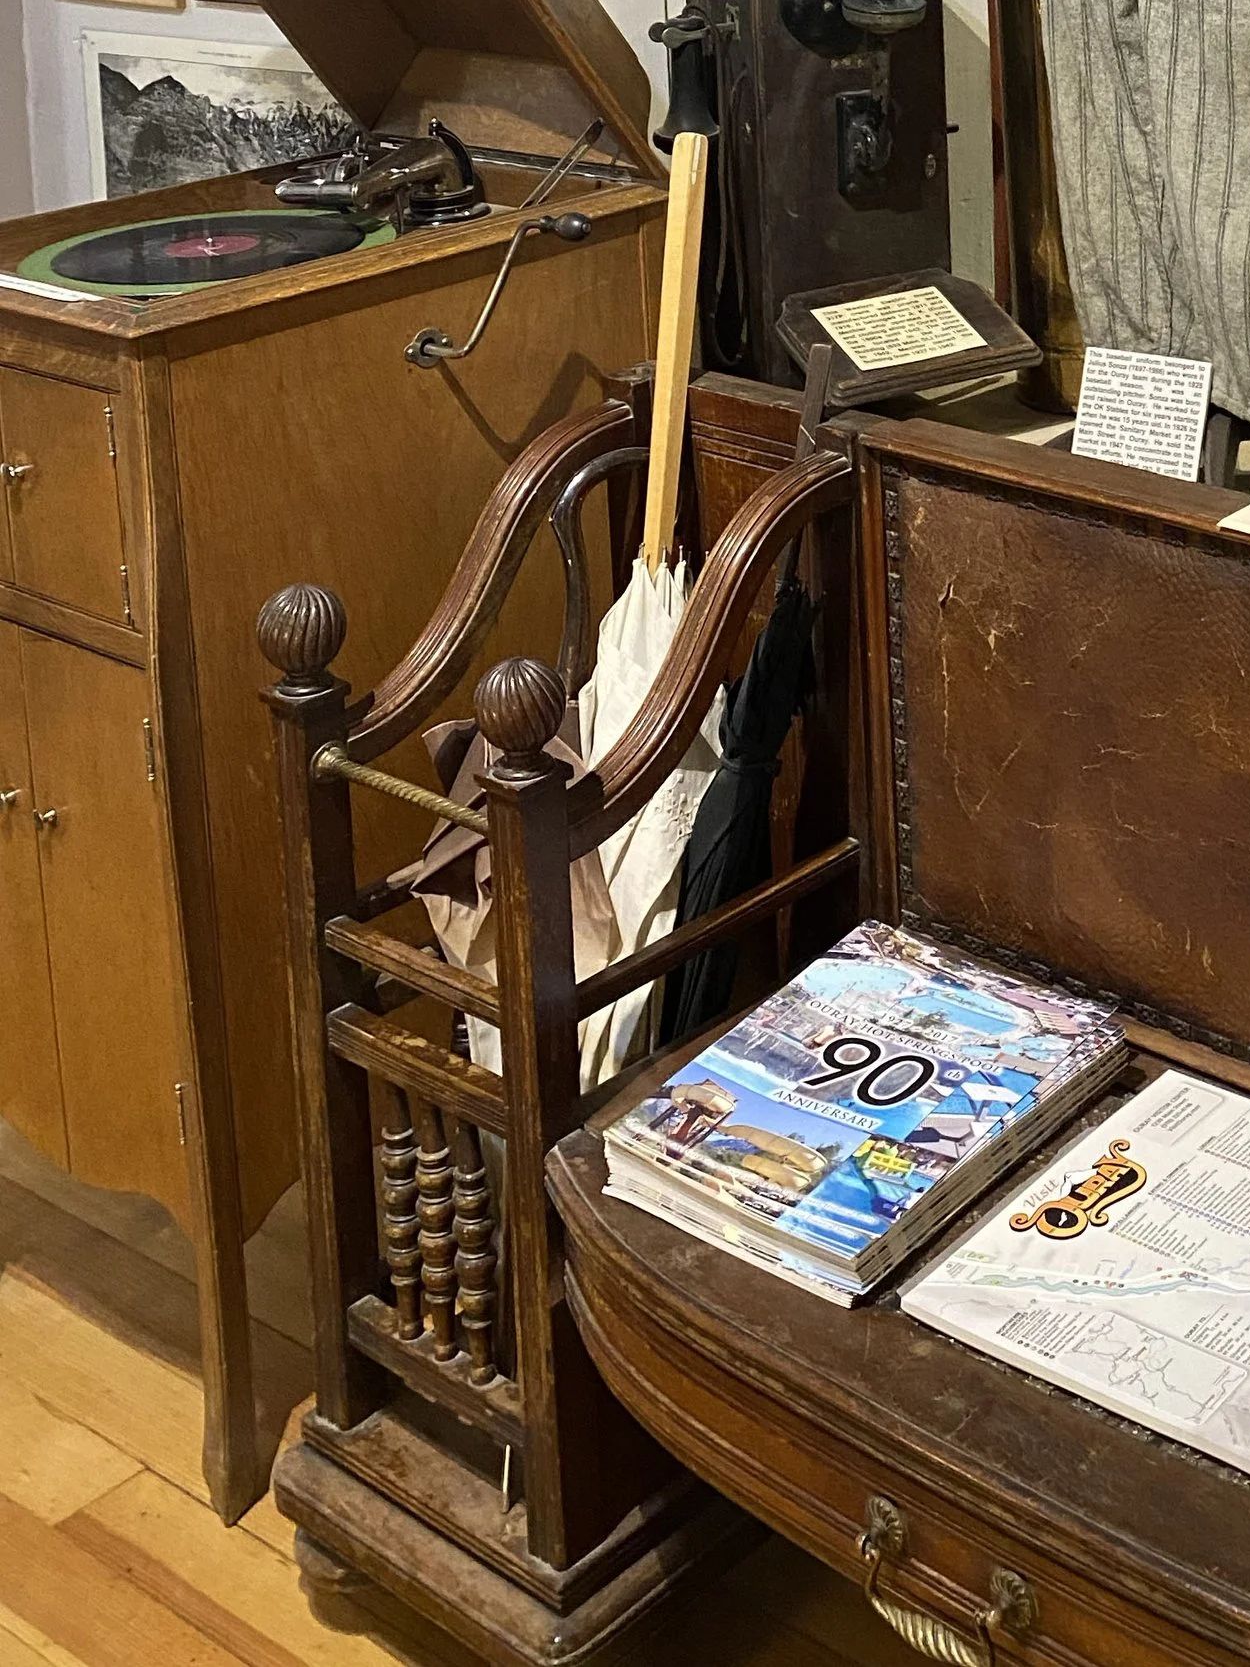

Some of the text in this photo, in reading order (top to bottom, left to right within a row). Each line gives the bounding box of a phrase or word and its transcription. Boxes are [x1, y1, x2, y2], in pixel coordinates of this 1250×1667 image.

[810, 1000, 1001, 1073] OURAY HOT SPRINGS POOL
[881, 1012, 958, 1043] 1927 2017
[804, 1037, 961, 1106] 90 th
[772, 1088, 882, 1131] ANNIVERSARY
[1009, 1139, 1147, 1239] OURAY
[1023, 1179, 1059, 1208] Visit
